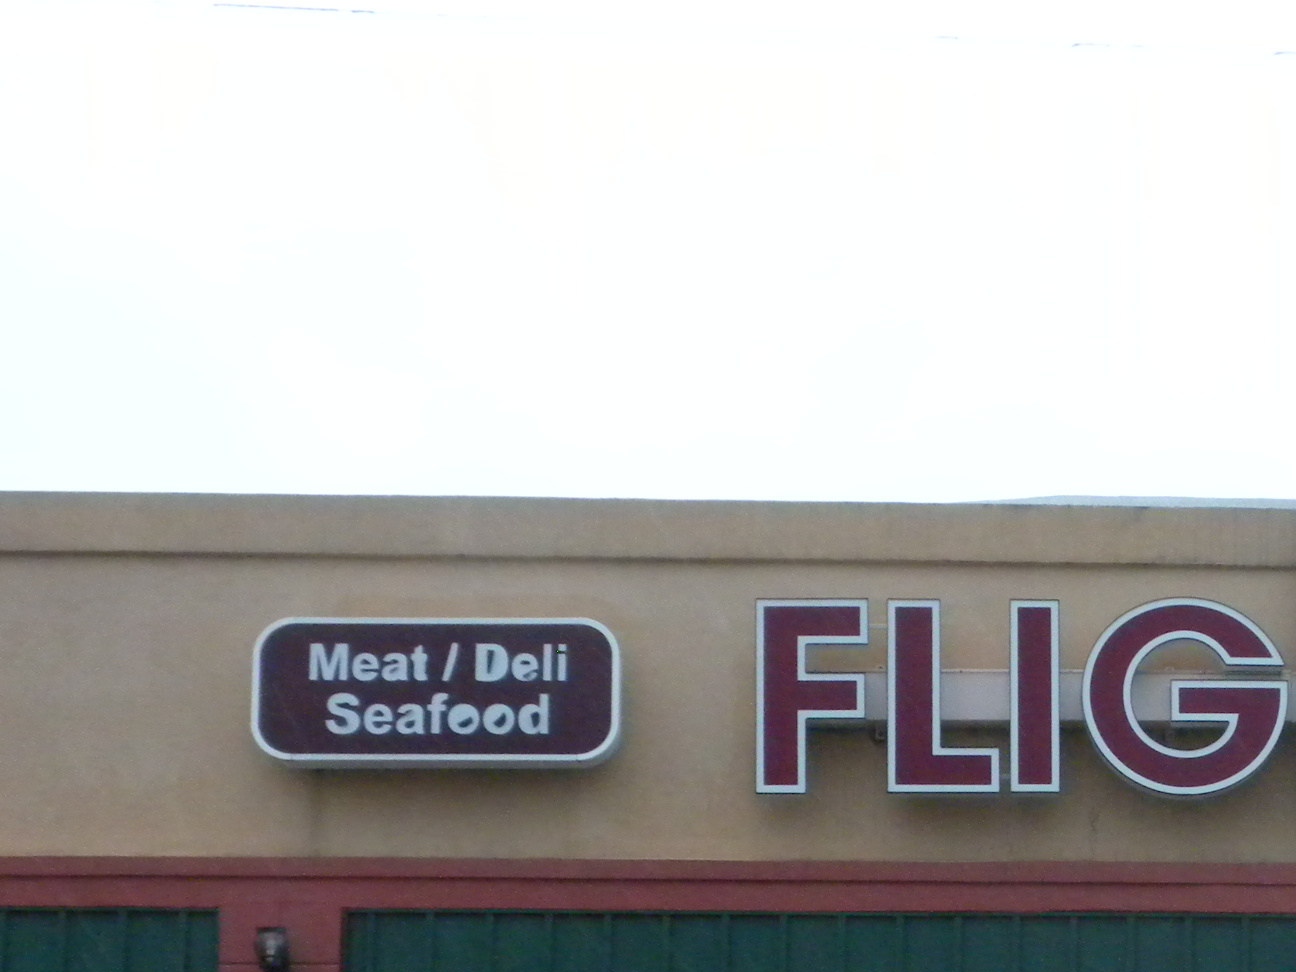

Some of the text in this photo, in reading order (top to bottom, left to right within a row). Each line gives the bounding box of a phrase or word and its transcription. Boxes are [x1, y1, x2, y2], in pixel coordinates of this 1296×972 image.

[308, 642, 568, 682] Meat / Deli
[325, 692, 550, 735] Seafood
